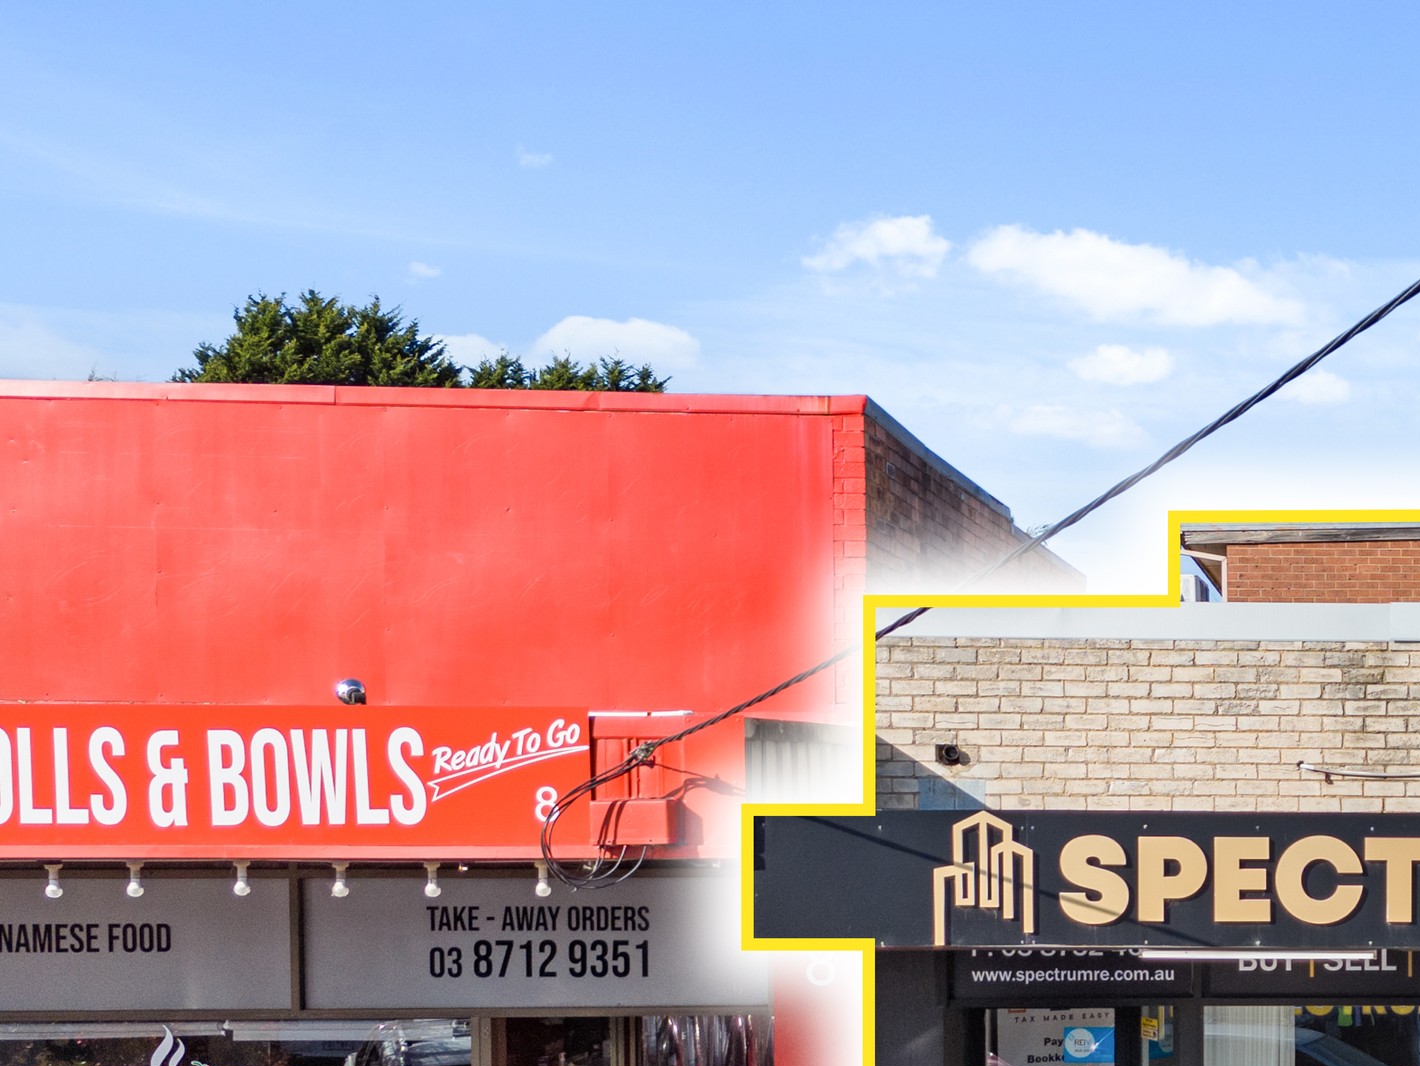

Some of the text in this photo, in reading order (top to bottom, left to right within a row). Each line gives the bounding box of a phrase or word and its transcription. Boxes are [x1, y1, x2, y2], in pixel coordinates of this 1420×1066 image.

[432, 719, 581, 774] Ready To Go
[0, 726, 427, 828] LLS & BOWLS
[535, 786, 560, 823] 8
[426, 906, 480, 932] TAKE
[502, 906, 561, 932] AWAY
[567, 906, 650, 932] ORDERS
[108, 923, 171, 953] FOOD
[429, 939, 649, 978] 03 8712 9351
[972, 967, 1175, 984] www.spectrumre.com.au
